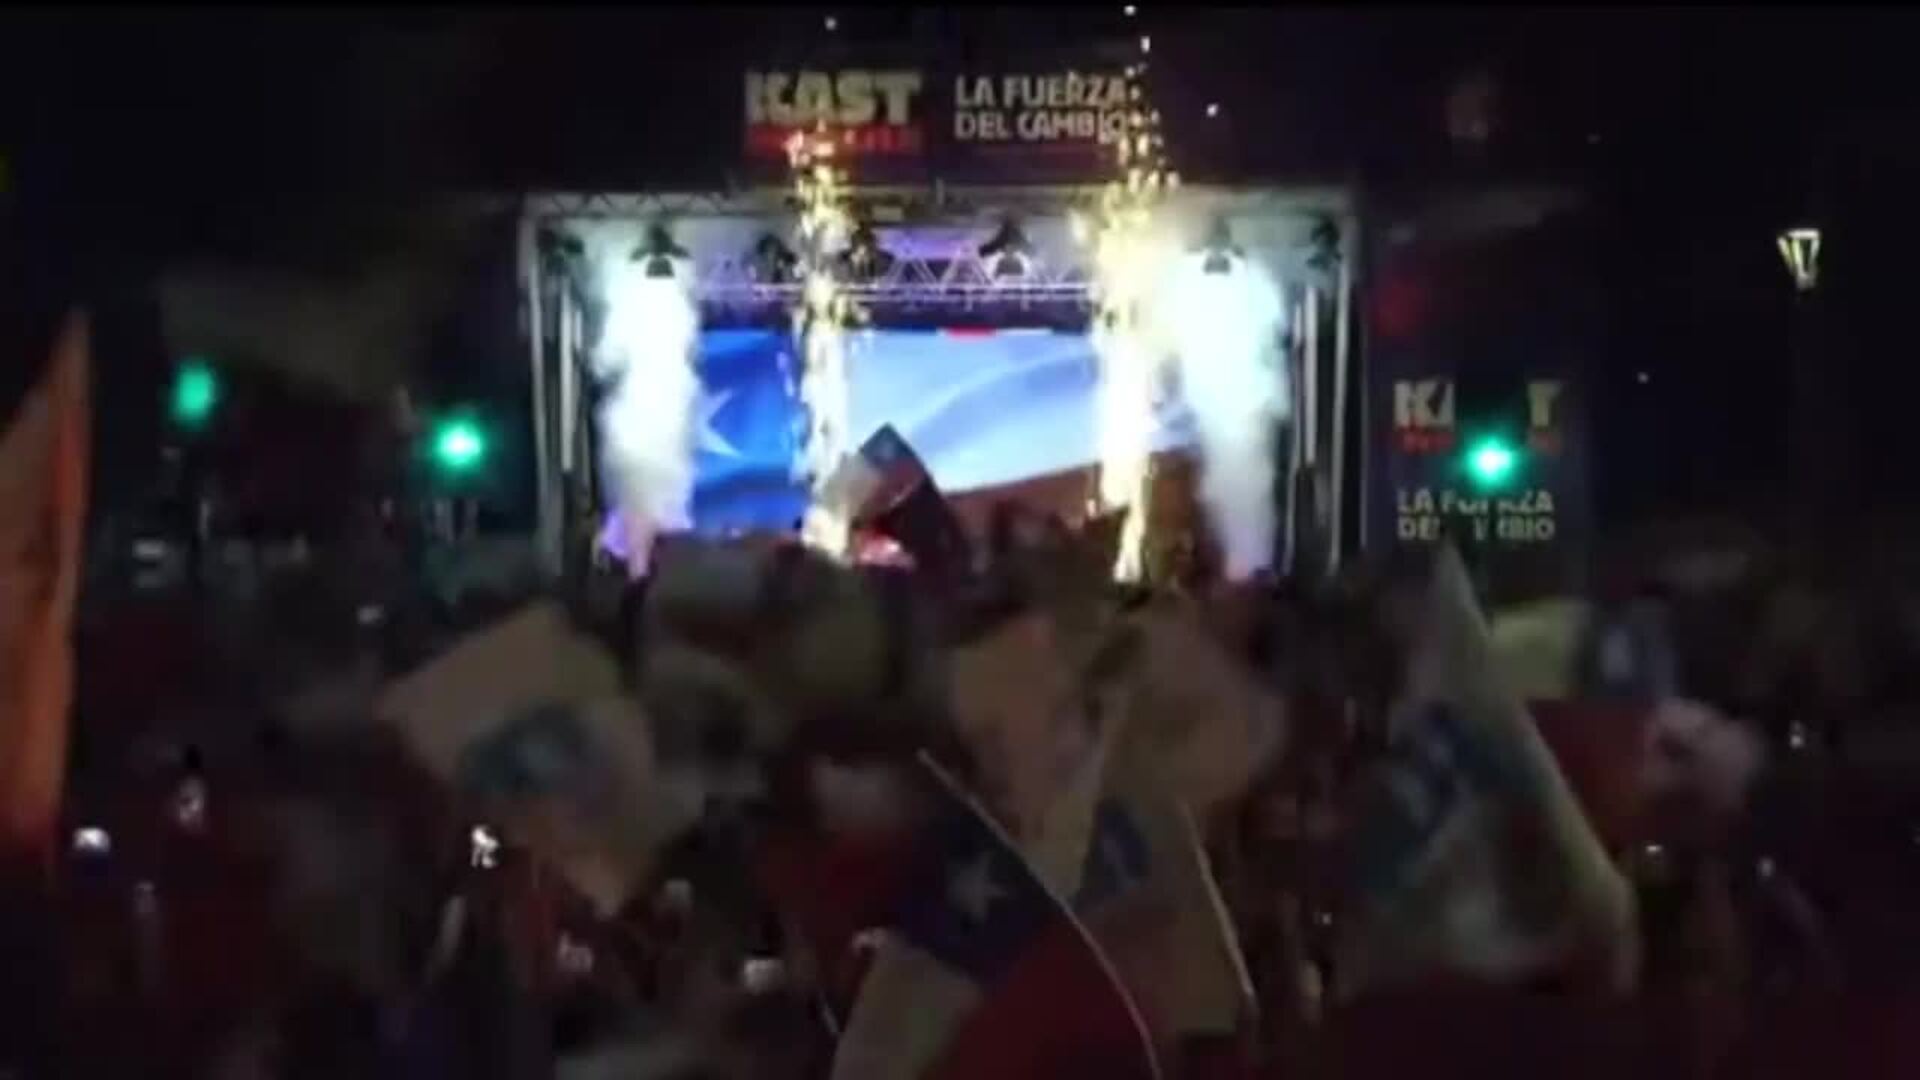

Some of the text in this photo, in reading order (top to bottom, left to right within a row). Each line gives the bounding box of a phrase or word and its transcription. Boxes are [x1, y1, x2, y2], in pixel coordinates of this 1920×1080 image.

[744, 70, 922, 124] KAST
[955, 75, 1127, 107] LA FUERZA
[954, 110, 1128, 143] DEL CAMBIO
[1394, 379, 1562, 428] KT
[1397, 488, 1434, 514] LA
